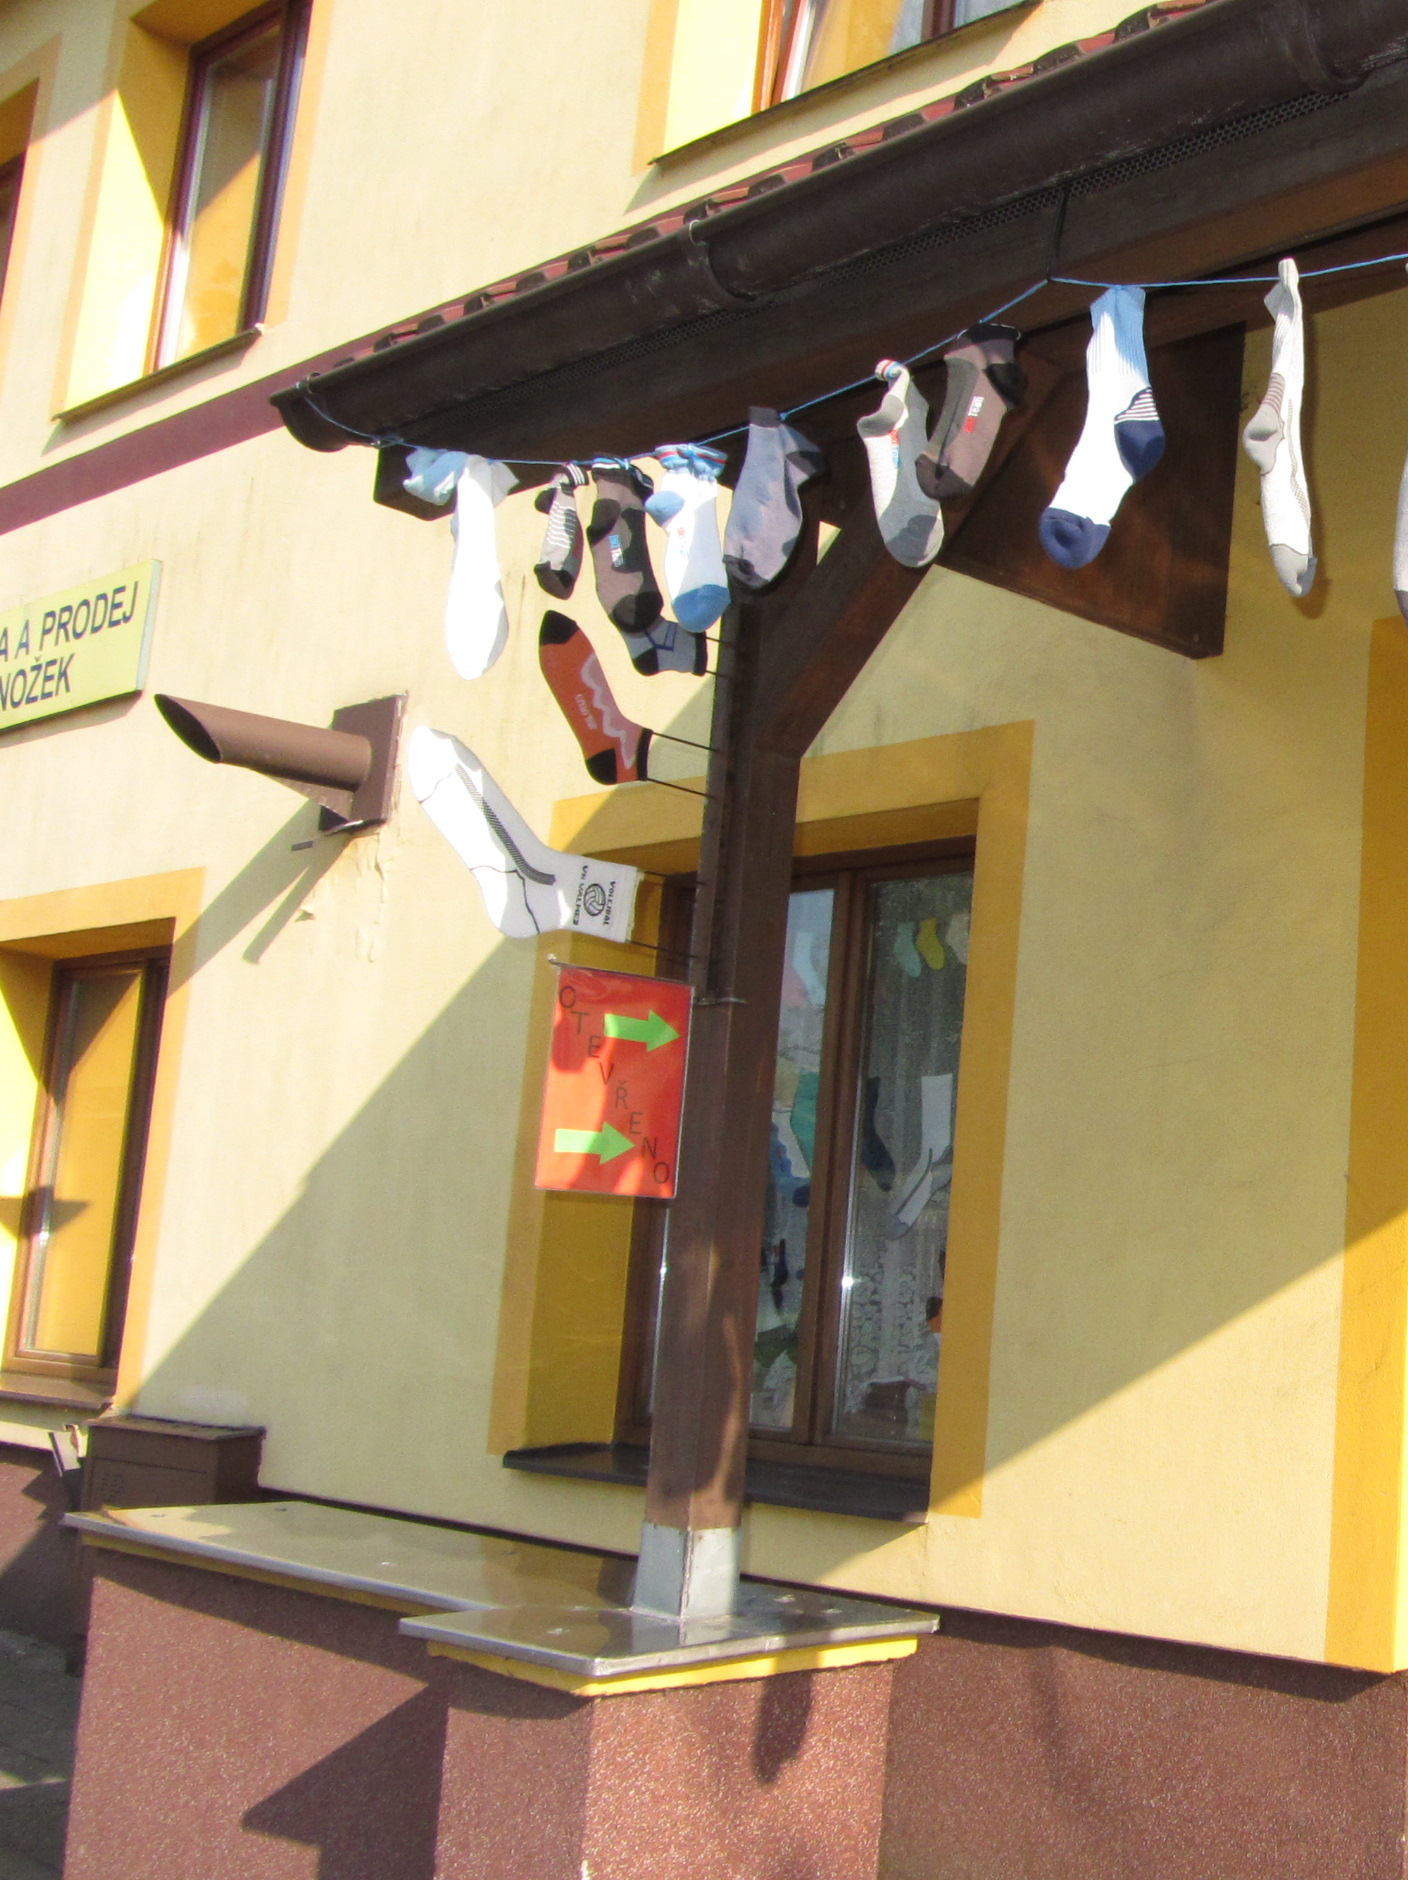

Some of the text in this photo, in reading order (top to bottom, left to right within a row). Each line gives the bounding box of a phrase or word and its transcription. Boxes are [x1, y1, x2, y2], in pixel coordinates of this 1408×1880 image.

[14, 619, 30, 660] A
[39, 580, 139, 652] PRODEJ
[0, 652, 76, 712] NOŽEK
